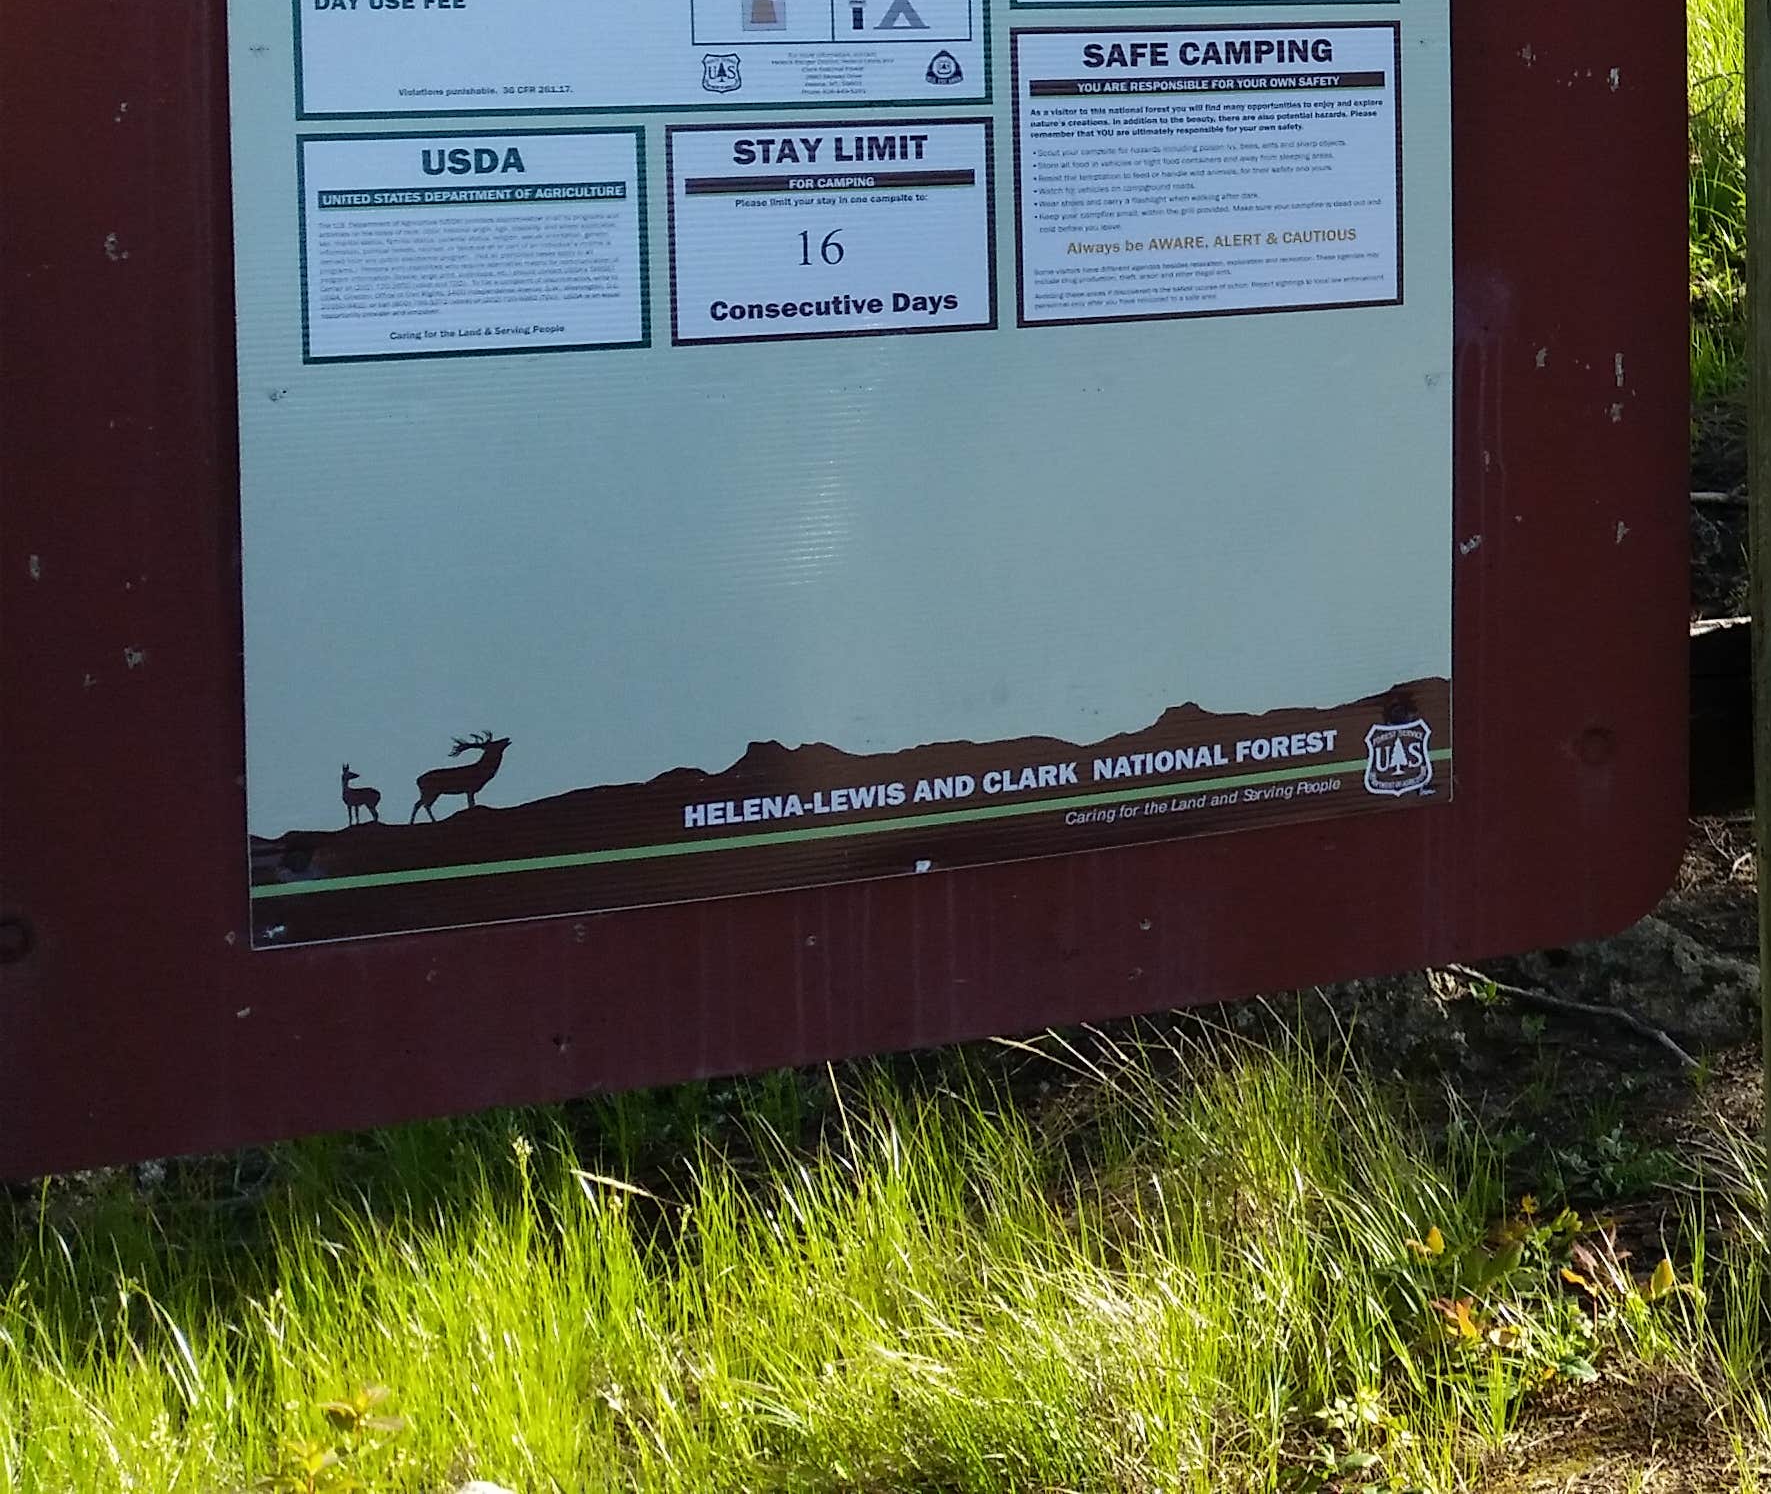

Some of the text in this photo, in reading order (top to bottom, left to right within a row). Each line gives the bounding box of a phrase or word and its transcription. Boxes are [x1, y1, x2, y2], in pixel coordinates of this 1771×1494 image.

[1083, 39, 1332, 67] SAFE CAMPING
[1077, 76, 1339, 92] YOU ARE RESPONSIBLE FOR YOUR OWN SAFETY
[422, 148, 525, 175] USDA
[733, 135, 928, 164] STAY LIMIT
[322, 185, 625, 205] UNITED STATES DEPARTMENT OF AGRICULTURE
[799, 229, 843, 265] 16
[711, 293, 957, 321] Consecutive Days
[684, 730, 1337, 829] HELENA-LEWIS AND CLARK NATIONAL FOREST
